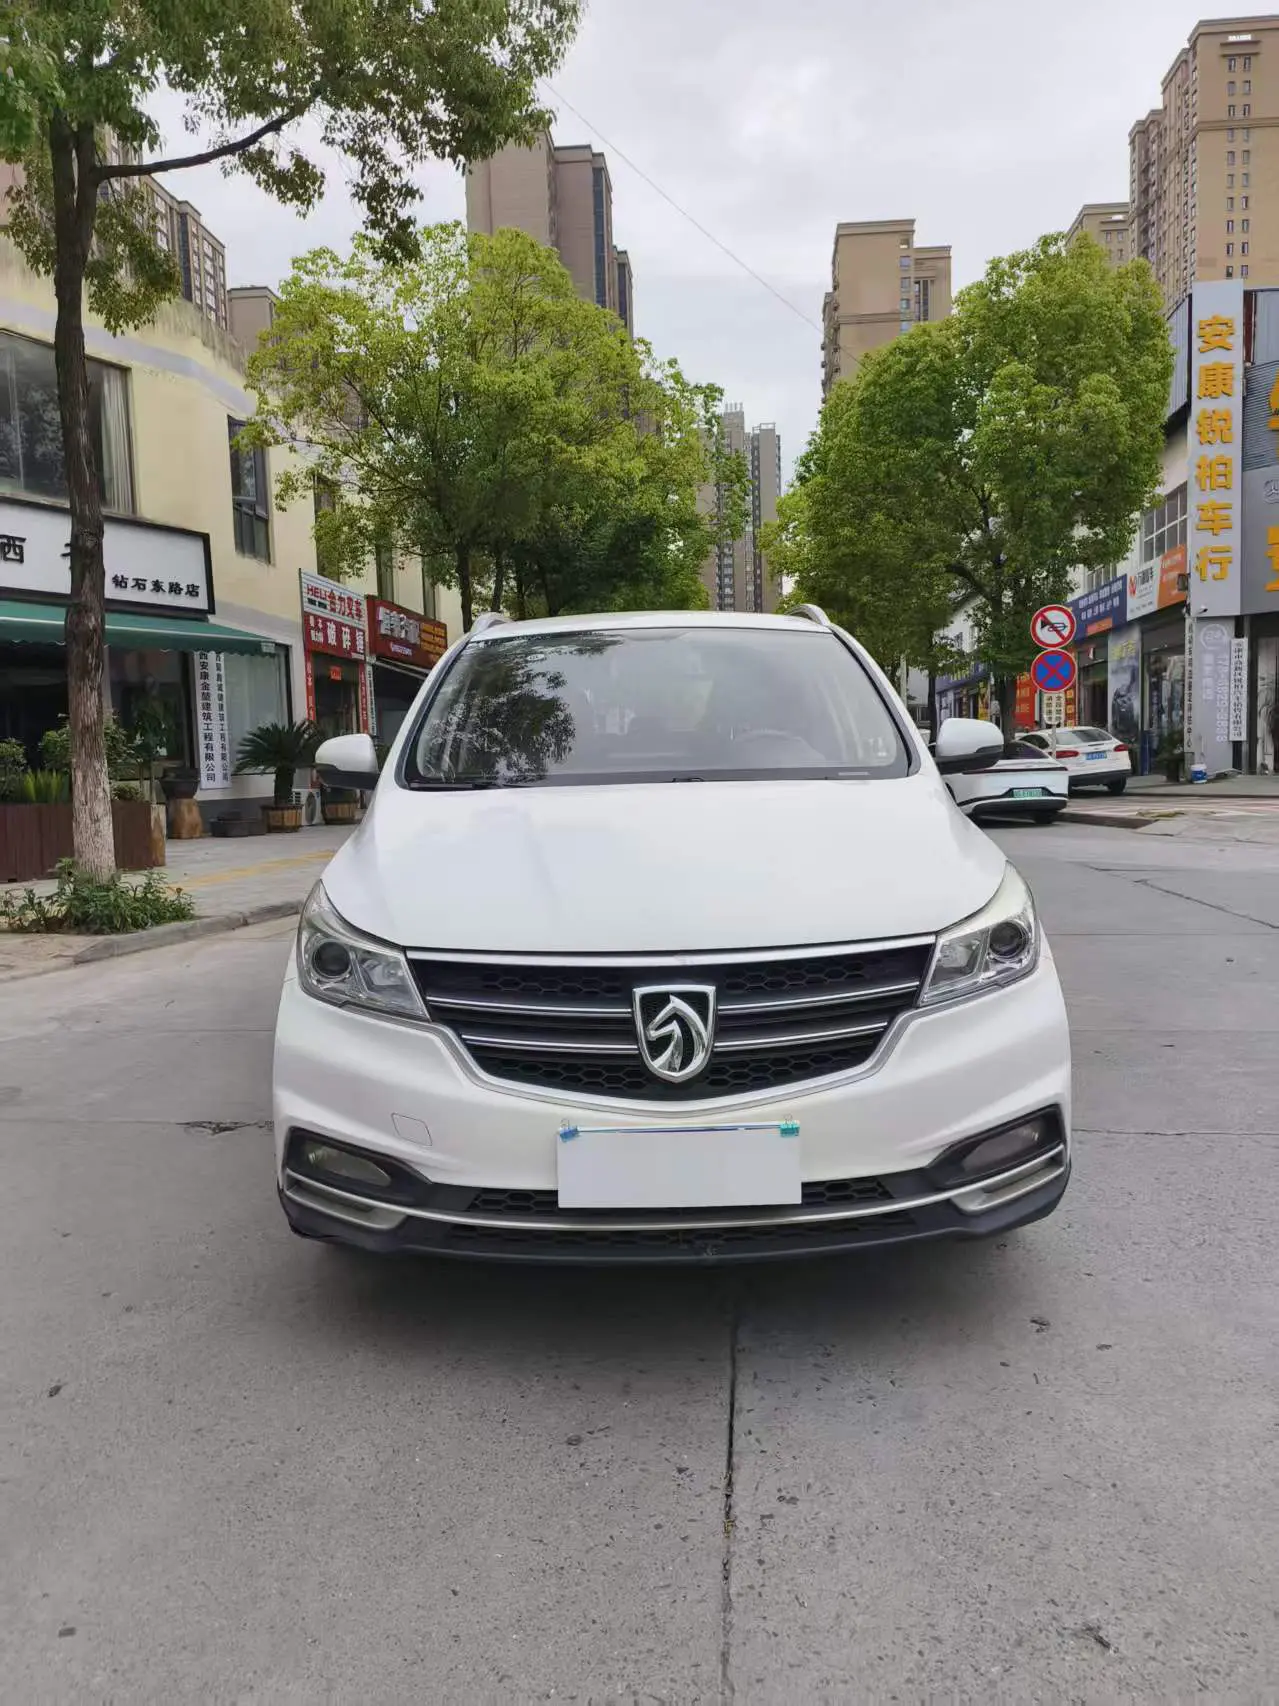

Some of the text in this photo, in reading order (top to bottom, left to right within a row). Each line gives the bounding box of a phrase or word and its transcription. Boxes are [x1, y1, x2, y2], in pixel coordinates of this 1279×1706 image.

[1196, 316, 1235, 581] 安康锐柏车行
[111, 574, 201, 598] 钻石东路店
